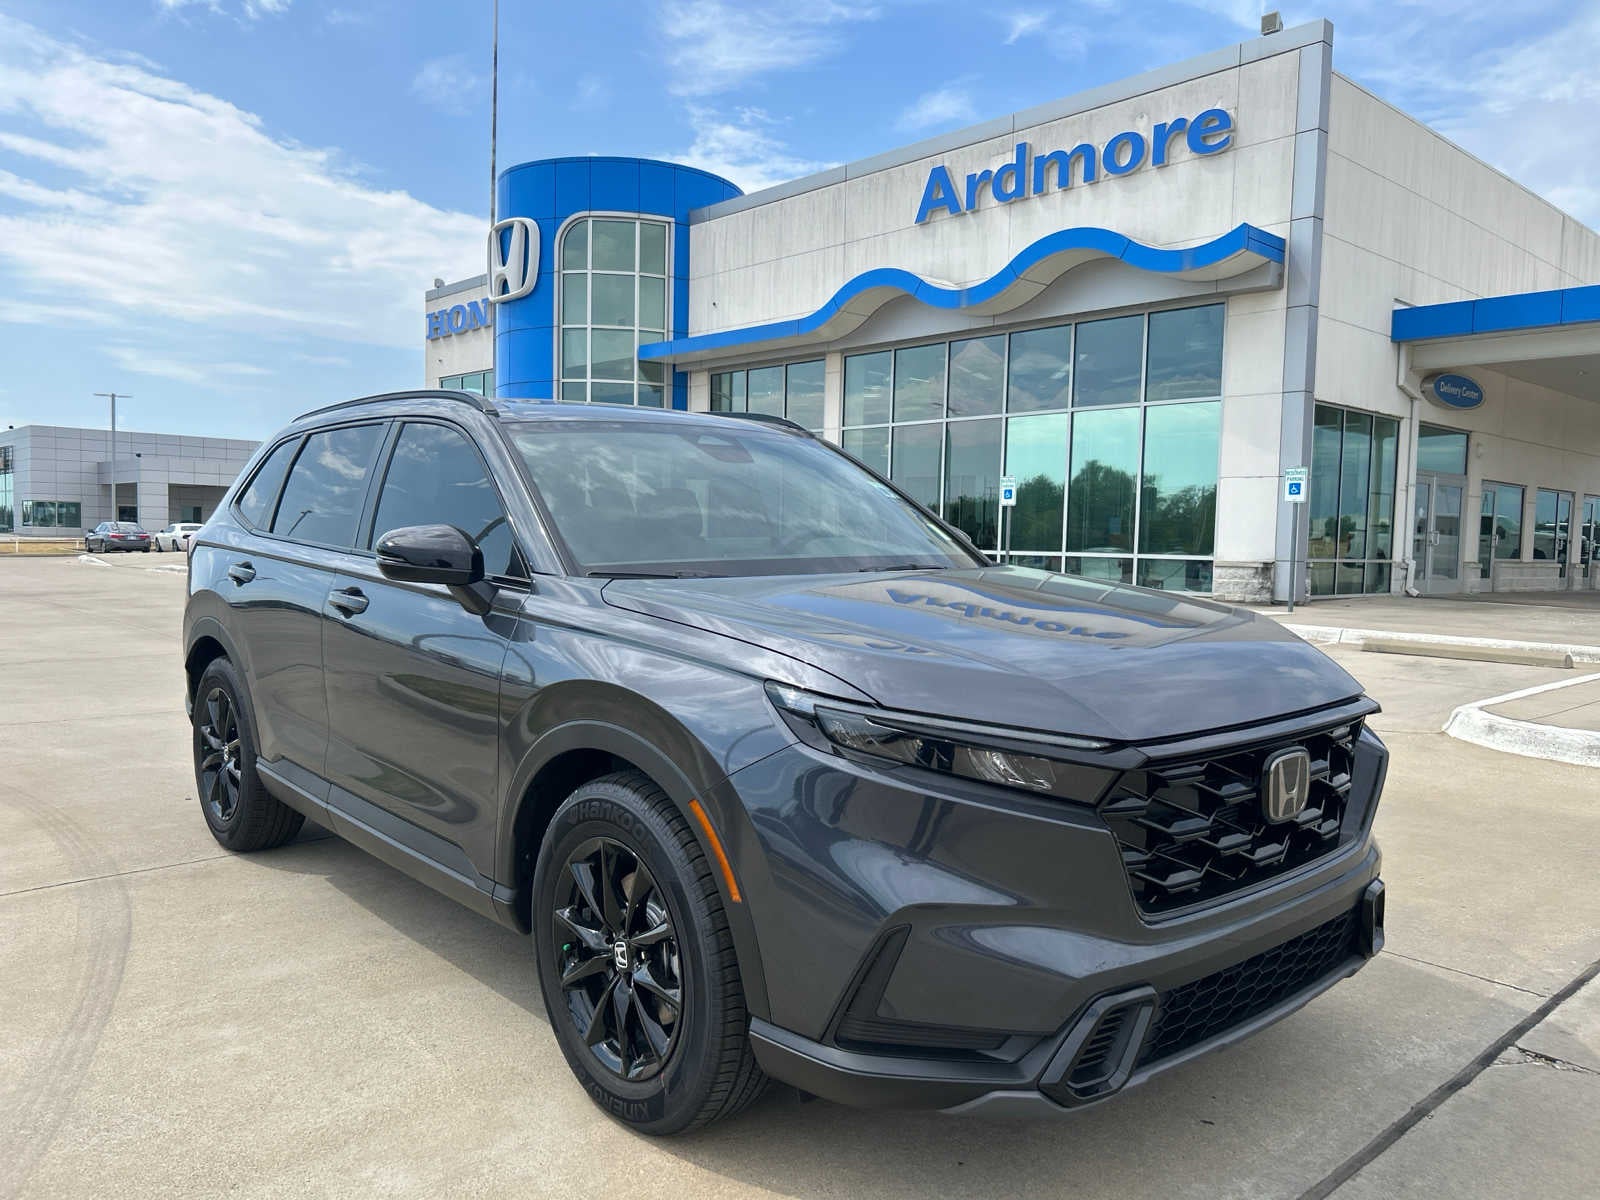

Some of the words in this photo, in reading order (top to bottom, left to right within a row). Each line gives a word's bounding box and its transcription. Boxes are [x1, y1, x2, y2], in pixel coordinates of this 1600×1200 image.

[914, 107, 1235, 224] Ardmore
[1440, 381, 1461, 398] Delivery
[1461, 386, 1479, 400] Center
